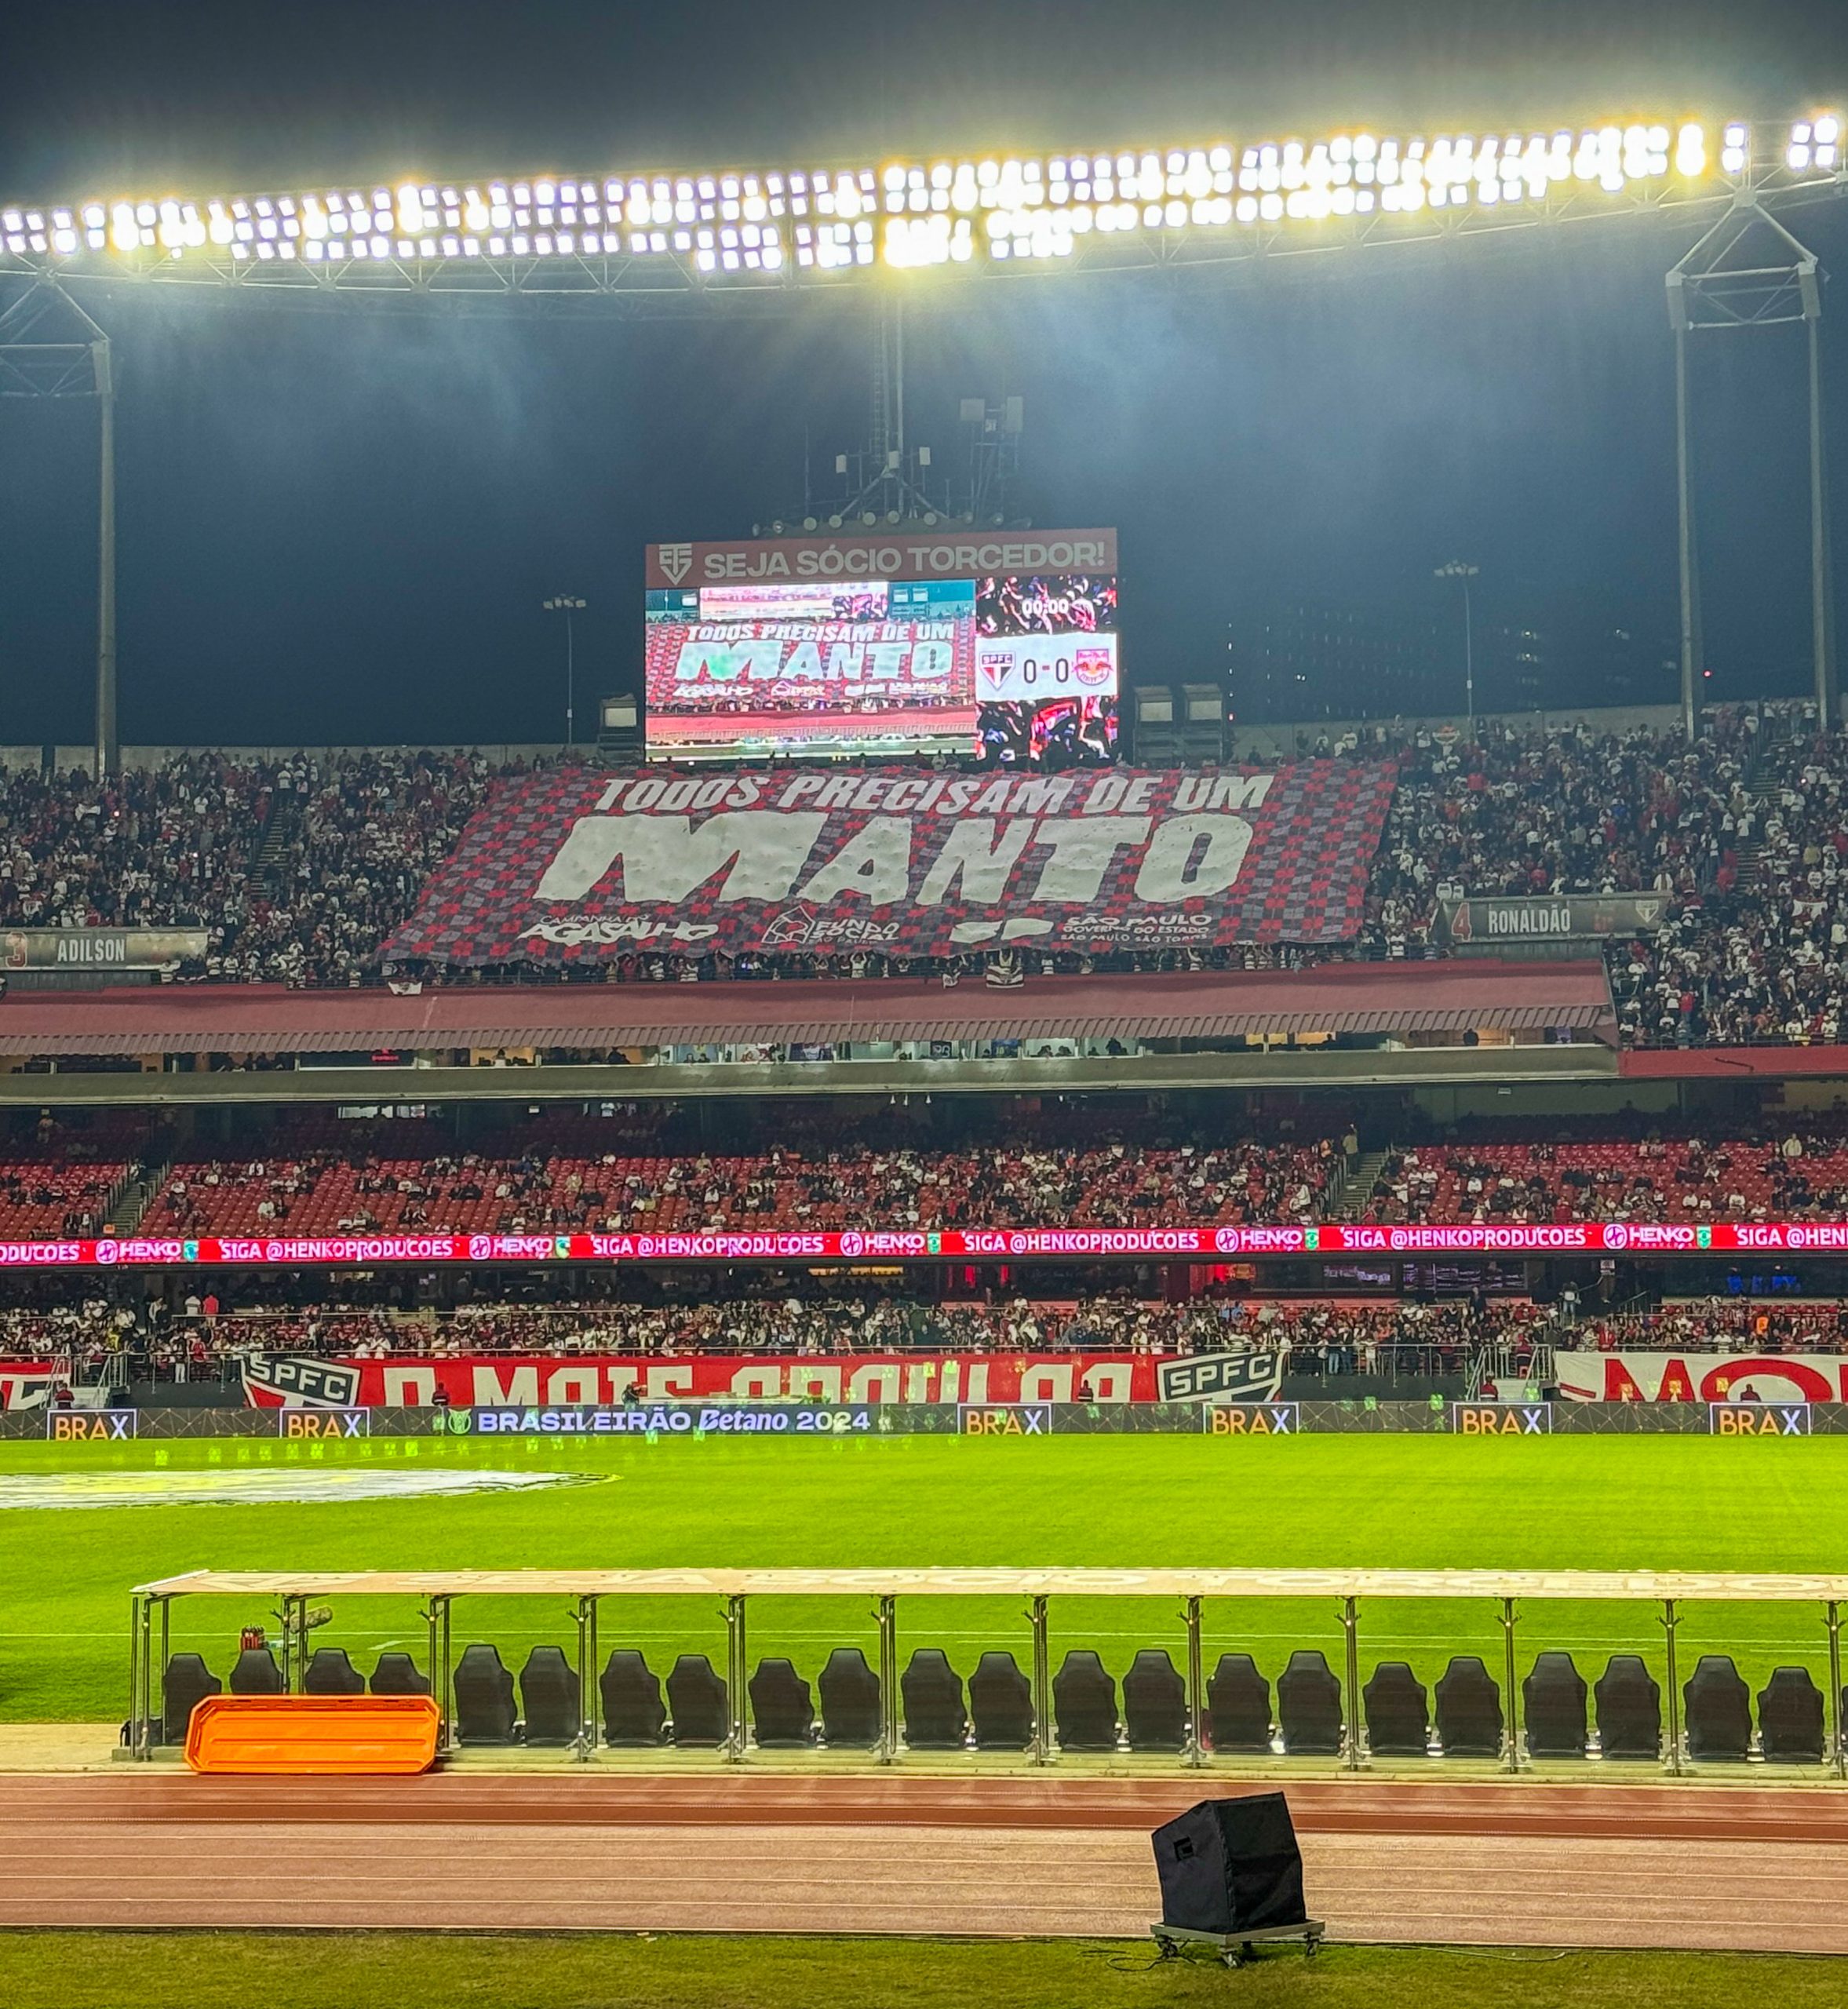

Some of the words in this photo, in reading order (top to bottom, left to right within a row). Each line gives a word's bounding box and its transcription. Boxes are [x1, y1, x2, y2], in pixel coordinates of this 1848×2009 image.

[704, 552, 791, 579] SEJA
[796, 544, 902, 576] SÓCIO
[908, 541, 1105, 572] TORCEDOR!
[1022, 599, 1070, 614] 00:00
[687, 624, 756, 642] TODOS
[760, 623, 873, 642] PRECISAM
[880, 623, 909, 640] DE
[915, 622, 955, 640] UM
[674, 640, 953, 680] MANTO
[594, 775, 771, 811] TODOS
[777, 775, 1073, 815] PRECISAM
[1083, 775, 1164, 814] DE
[1172, 775, 1275, 811] UM
[531, 811, 1254, 906] MANTO
[540, 915, 621, 924] CAMPANHA
[815, 919, 900, 934] FUNDO
[1065, 913, 1121, 926] SÃO
[1126, 914, 1212, 927] PAULO
[1452, 902, 1472, 942] 4
[1488, 904, 1570, 934] RONALDÃO
[516, 921, 719, 946] AGASALHO
[5, 932, 28, 968] 3
[57, 939, 126, 962] ADILSON
[248, 1359, 347, 1401] SPFC
[1168, 1355, 1272, 1396] SPFC
[55, 1416, 129, 1442] BRAX
[288, 1415, 361, 1439] BRAX
[478, 1407, 691, 1432] BRASILEIRÃO
[699, 1409, 787, 1431] Betano
[796, 1411, 870, 1431] 2024
[966, 1409, 1043, 1435] BRAX
[1212, 1409, 1290, 1435] BRAX
[1462, 1410, 1542, 1435] BRAX
[1719, 1410, 1801, 1435] BRAX
